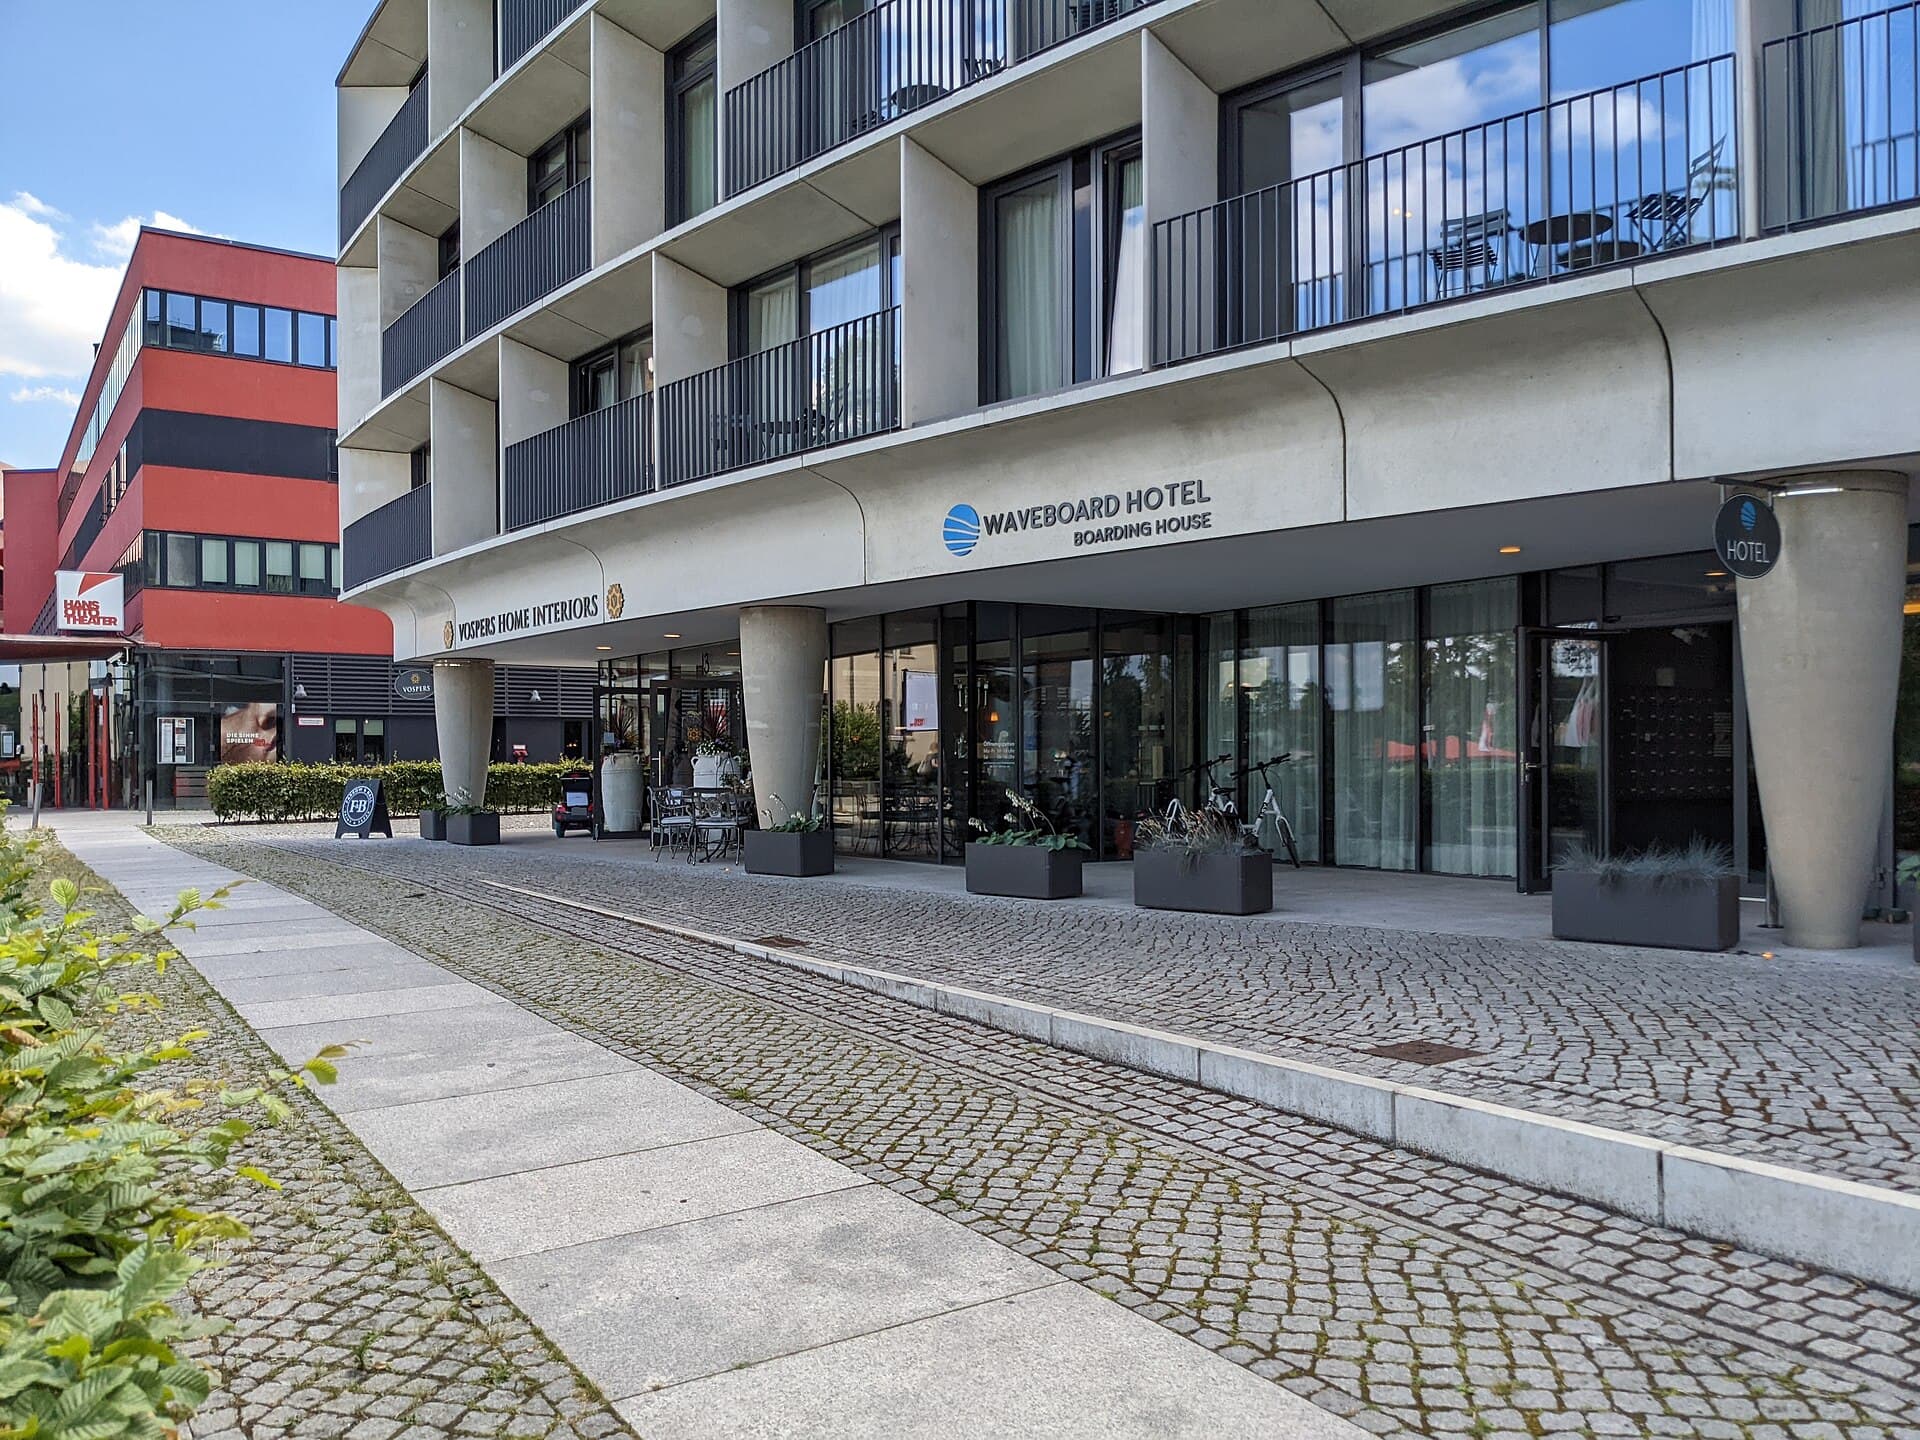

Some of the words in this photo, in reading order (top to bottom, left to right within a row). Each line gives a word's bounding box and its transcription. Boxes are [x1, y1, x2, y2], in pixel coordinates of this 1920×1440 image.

[983, 493, 1120, 536] WAVEBOARD
[1126, 480, 1211, 514] HOTEL
[1073, 521, 1151, 547] BOARDING
[1155, 512, 1212, 535] HOUSE
[1727, 540, 1770, 563] HOTEL
[64, 600, 99, 610] HANS
[64, 609, 99, 618] OTTO
[65, 616, 118, 625] THEATER
[459, 616, 496, 641] VOSPERS
[498, 608, 529, 633] HOME
[532, 594, 598, 627] INTERIORS
[402, 685, 430, 693] VOSPERS
